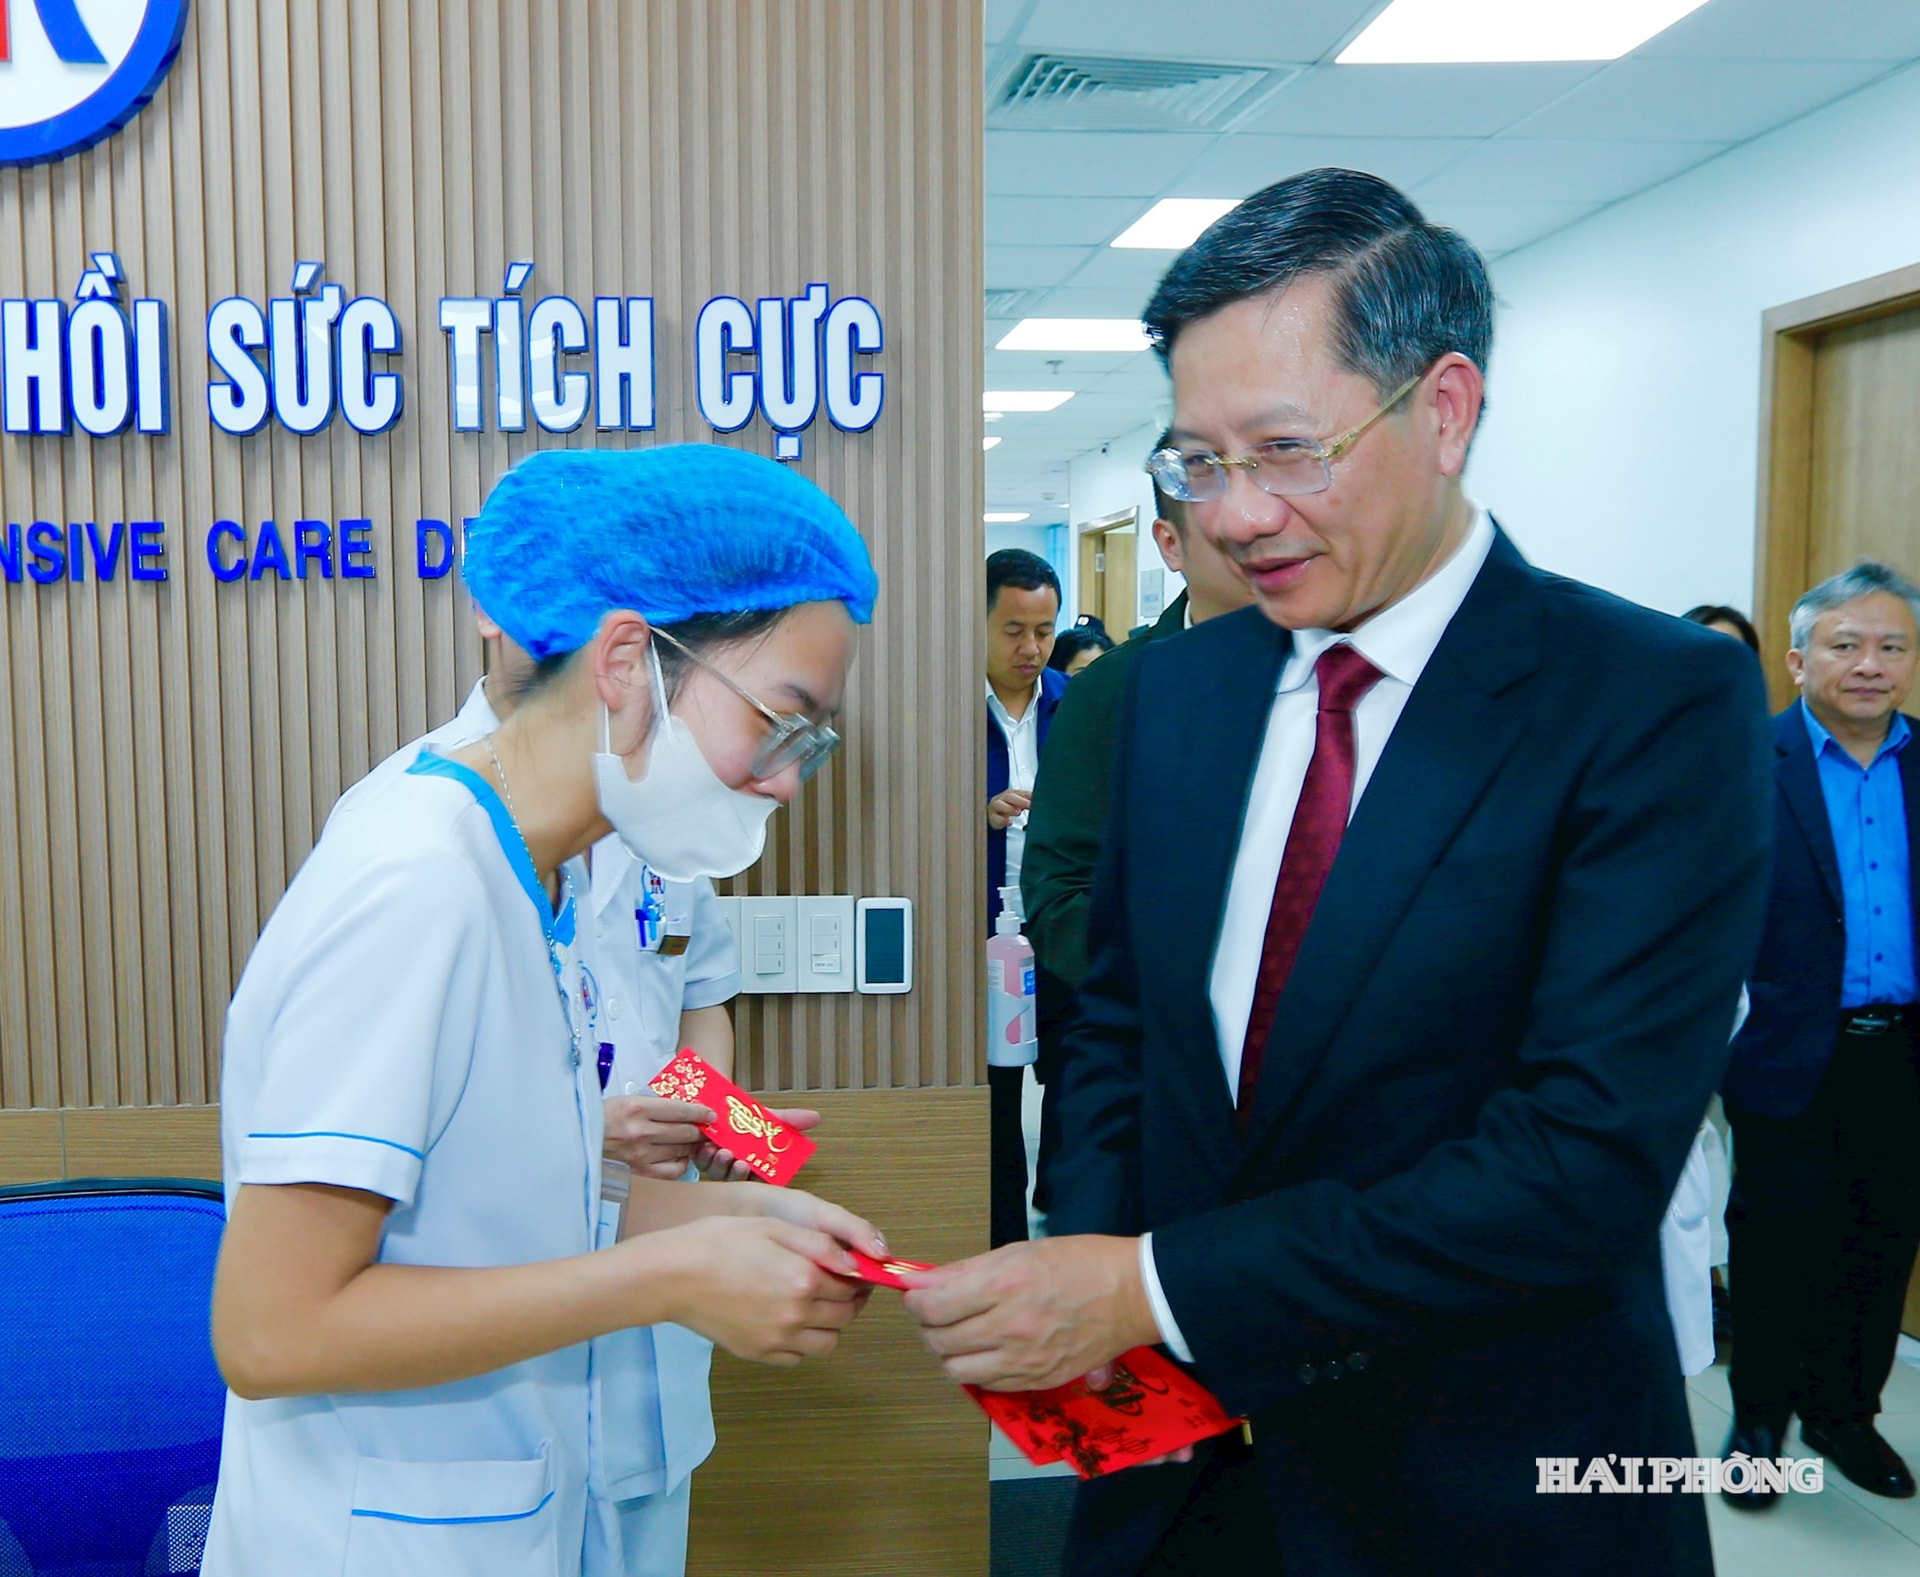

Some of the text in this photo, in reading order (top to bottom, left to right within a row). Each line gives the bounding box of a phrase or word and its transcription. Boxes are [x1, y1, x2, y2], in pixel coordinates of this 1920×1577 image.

[2, 252, 885, 460] HỒI SỨC TÍCH CỰC
[206, 519, 376, 582] CARE
